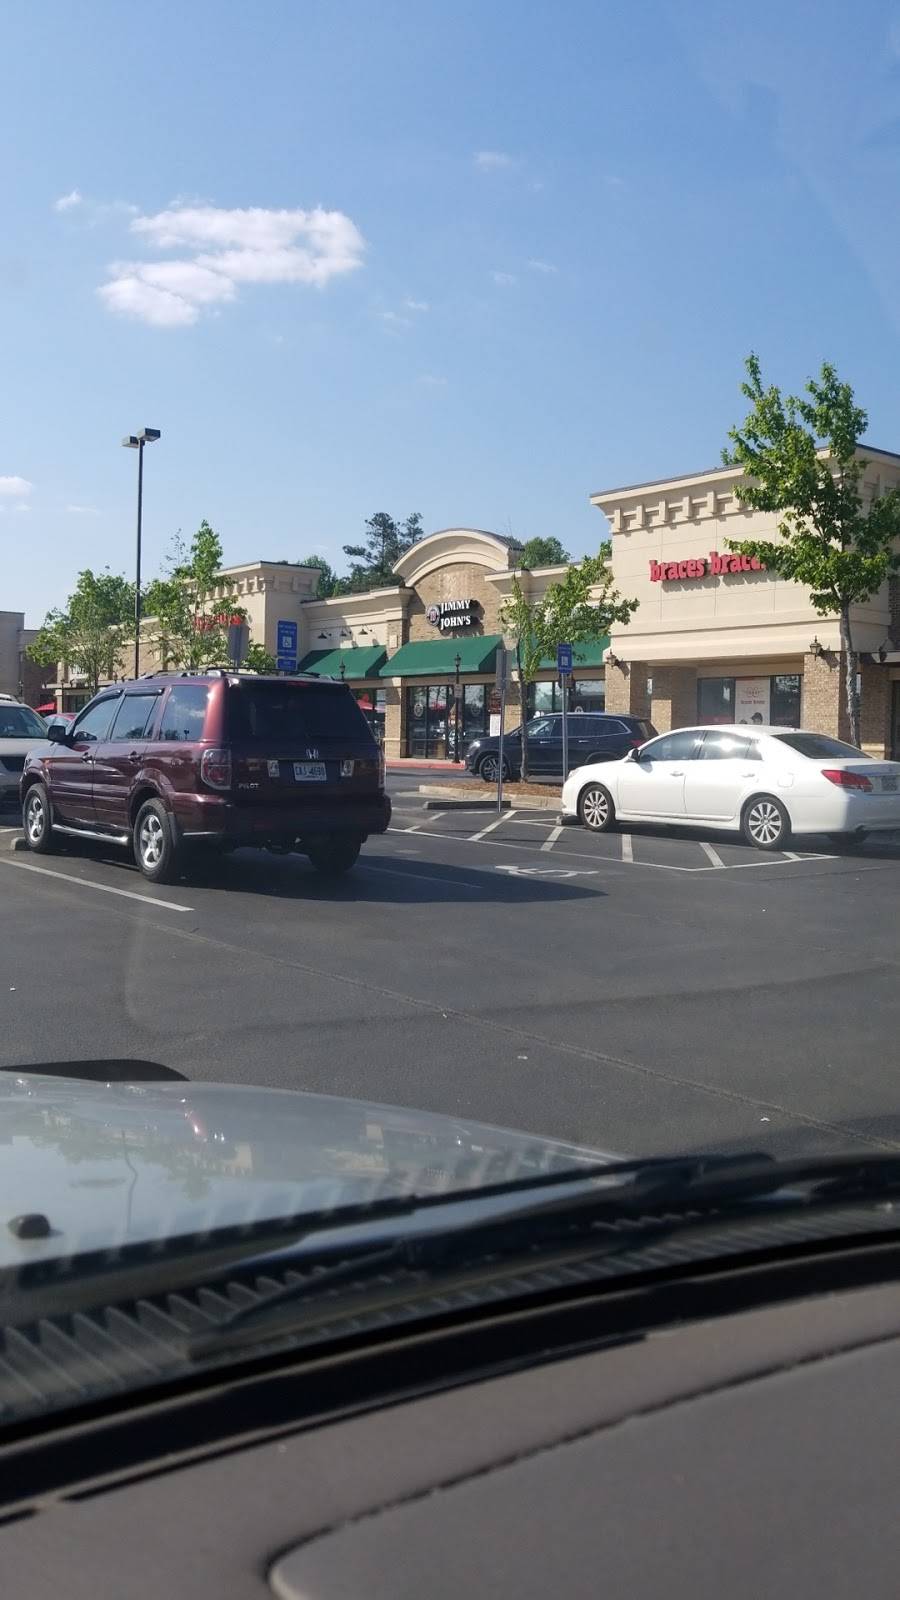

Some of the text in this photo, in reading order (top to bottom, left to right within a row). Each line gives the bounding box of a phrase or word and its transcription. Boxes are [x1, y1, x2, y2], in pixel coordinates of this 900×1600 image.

[649, 559, 705, 582] braces
[440, 599, 471, 615] JIMMY
[440, 615, 471, 631] JOHN'S
